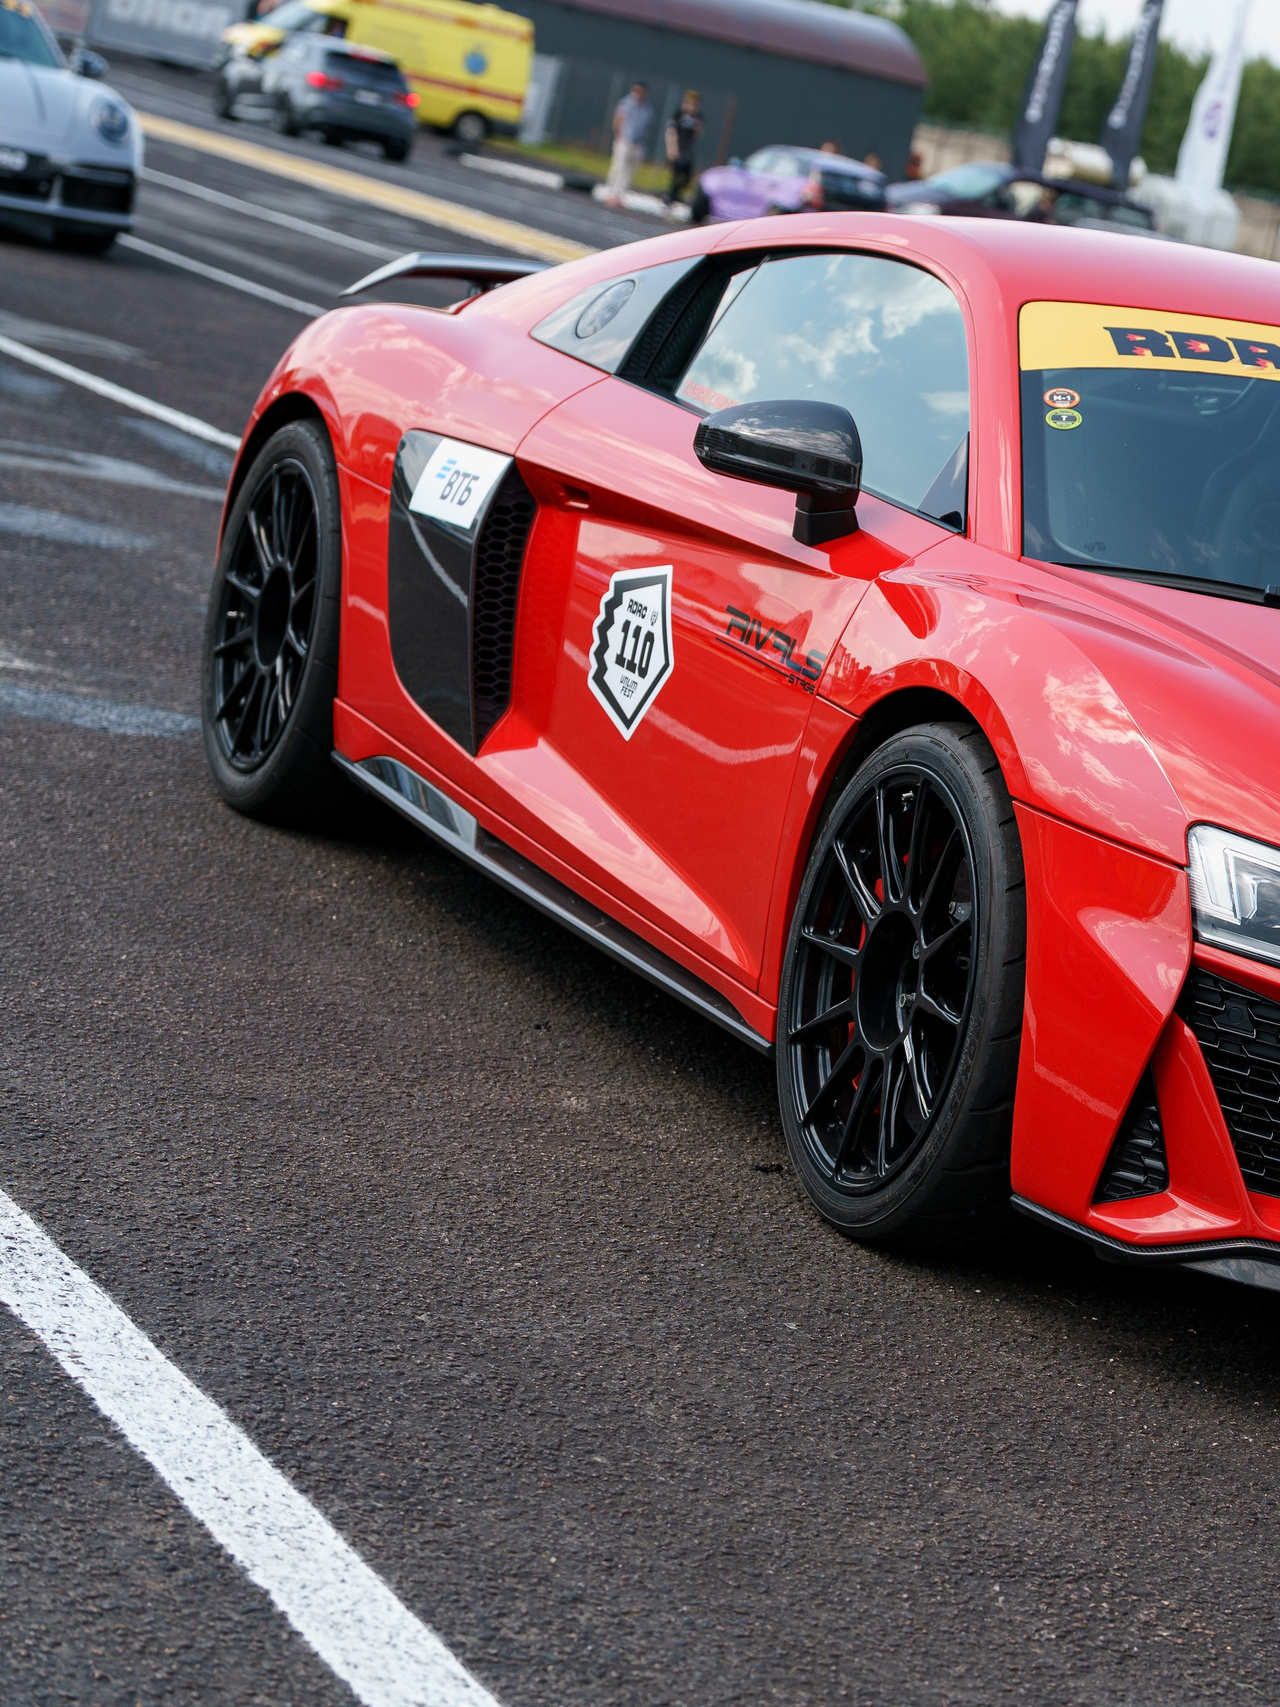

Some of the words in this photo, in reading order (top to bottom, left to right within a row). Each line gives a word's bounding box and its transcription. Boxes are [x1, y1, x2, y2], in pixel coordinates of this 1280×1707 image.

[439, 469, 480, 506] ВТБ
[626, 598, 648, 619] RDRC
[614, 619, 655, 679] 110
[726, 604, 828, 682] RIVALS
[619, 685, 635, 699] FEST
